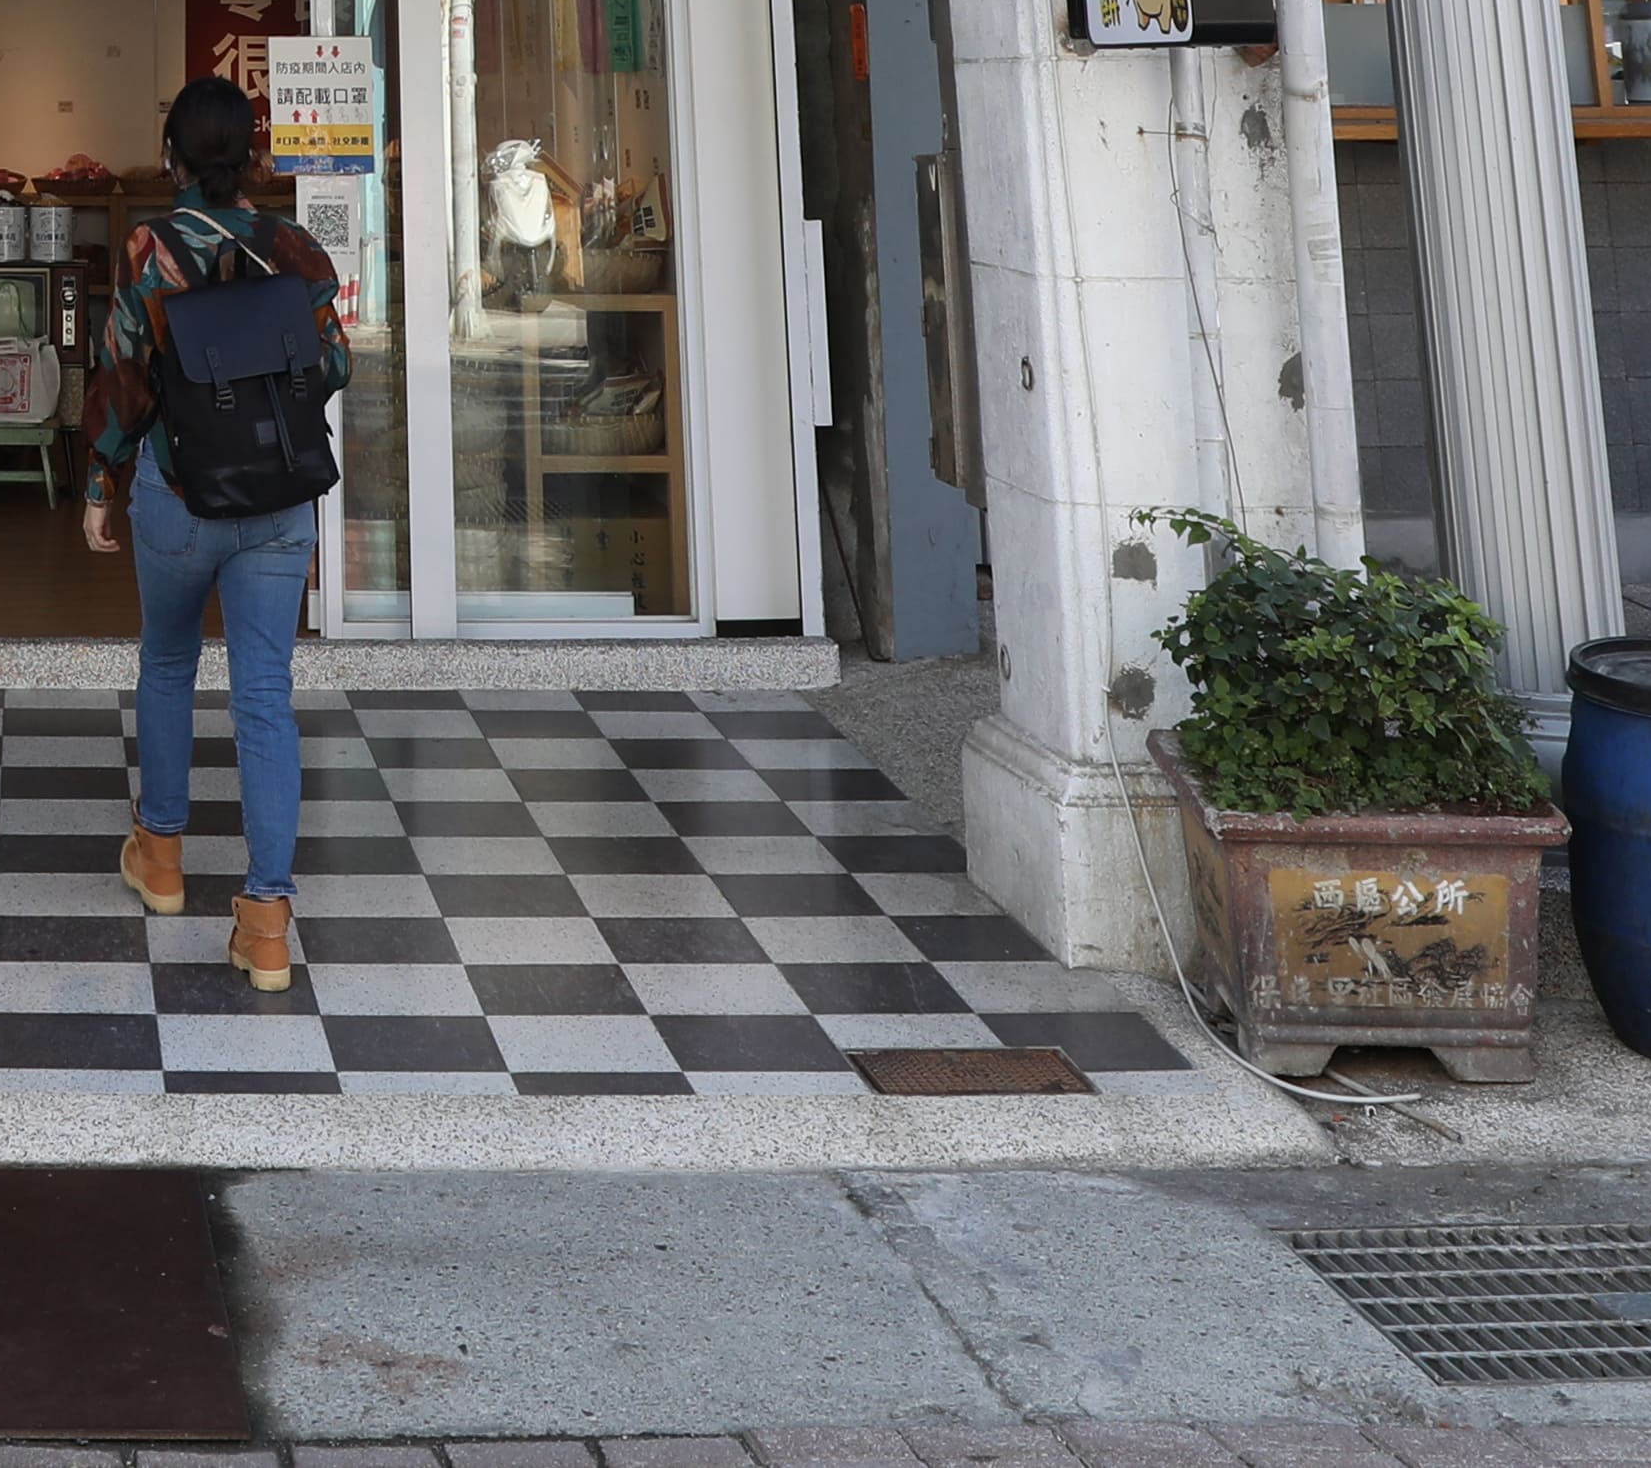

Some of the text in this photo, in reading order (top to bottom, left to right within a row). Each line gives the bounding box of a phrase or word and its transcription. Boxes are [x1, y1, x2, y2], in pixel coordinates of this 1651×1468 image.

[275, 61, 366, 75] 防疫期間入店內
[1311, 877, 1468, 917] 西區公所
